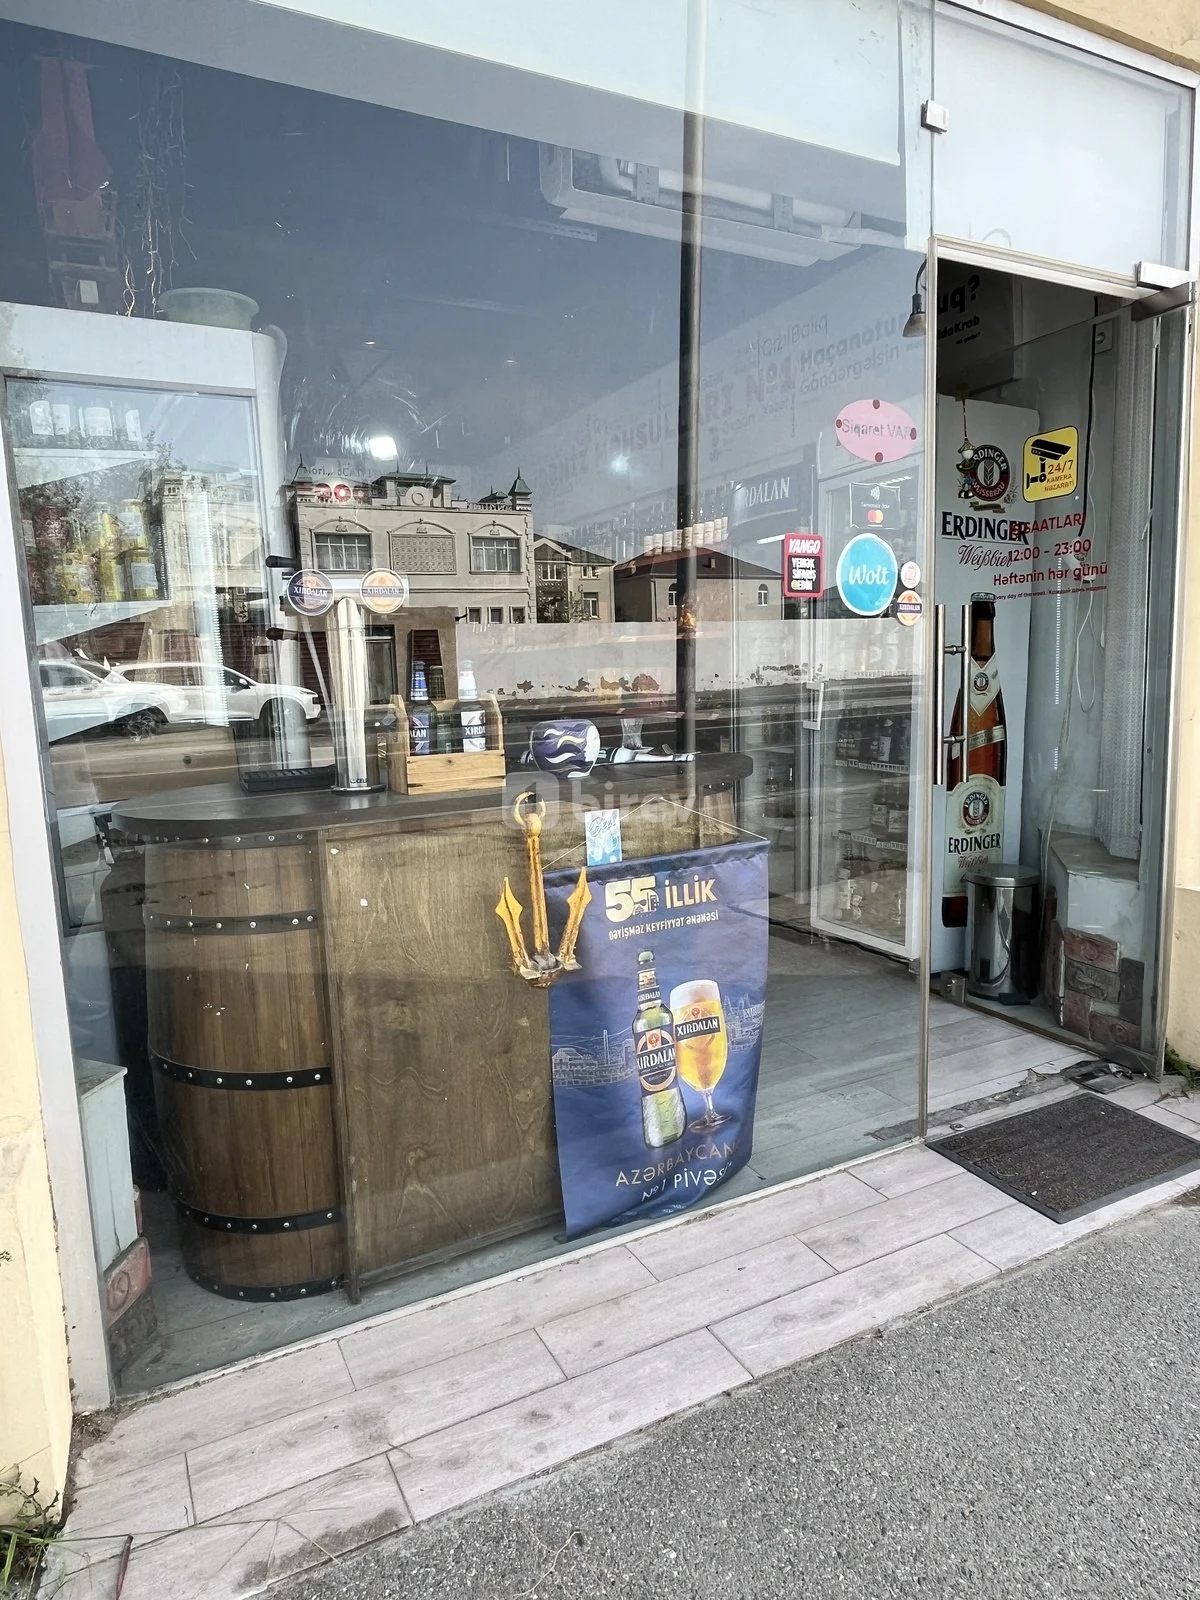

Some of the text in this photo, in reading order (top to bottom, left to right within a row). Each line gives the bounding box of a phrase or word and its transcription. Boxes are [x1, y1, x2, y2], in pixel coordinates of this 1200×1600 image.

[970, 447, 1008, 472] RDINGER
[1047, 460, 1073, 475] 24/7
[1046, 473, 1072, 484] KAMERA
[941, 511, 1030, 546] ERDINGER
[788, 538, 821, 555] YANGO
[1054, 539, 1092, 557] 23:00
[848, 563, 890, 586] Wolt
[993, 561, 1109, 587] Həftənin hər günü
[293, 585, 329, 599] XIRDALAN
[365, 587, 400, 596] XIRDALAN
[948, 833, 1002, 855] ERDINGER
[605, 874, 718, 923] 55 İLLİK
[676, 1018, 719, 1037] XIRDALAN
